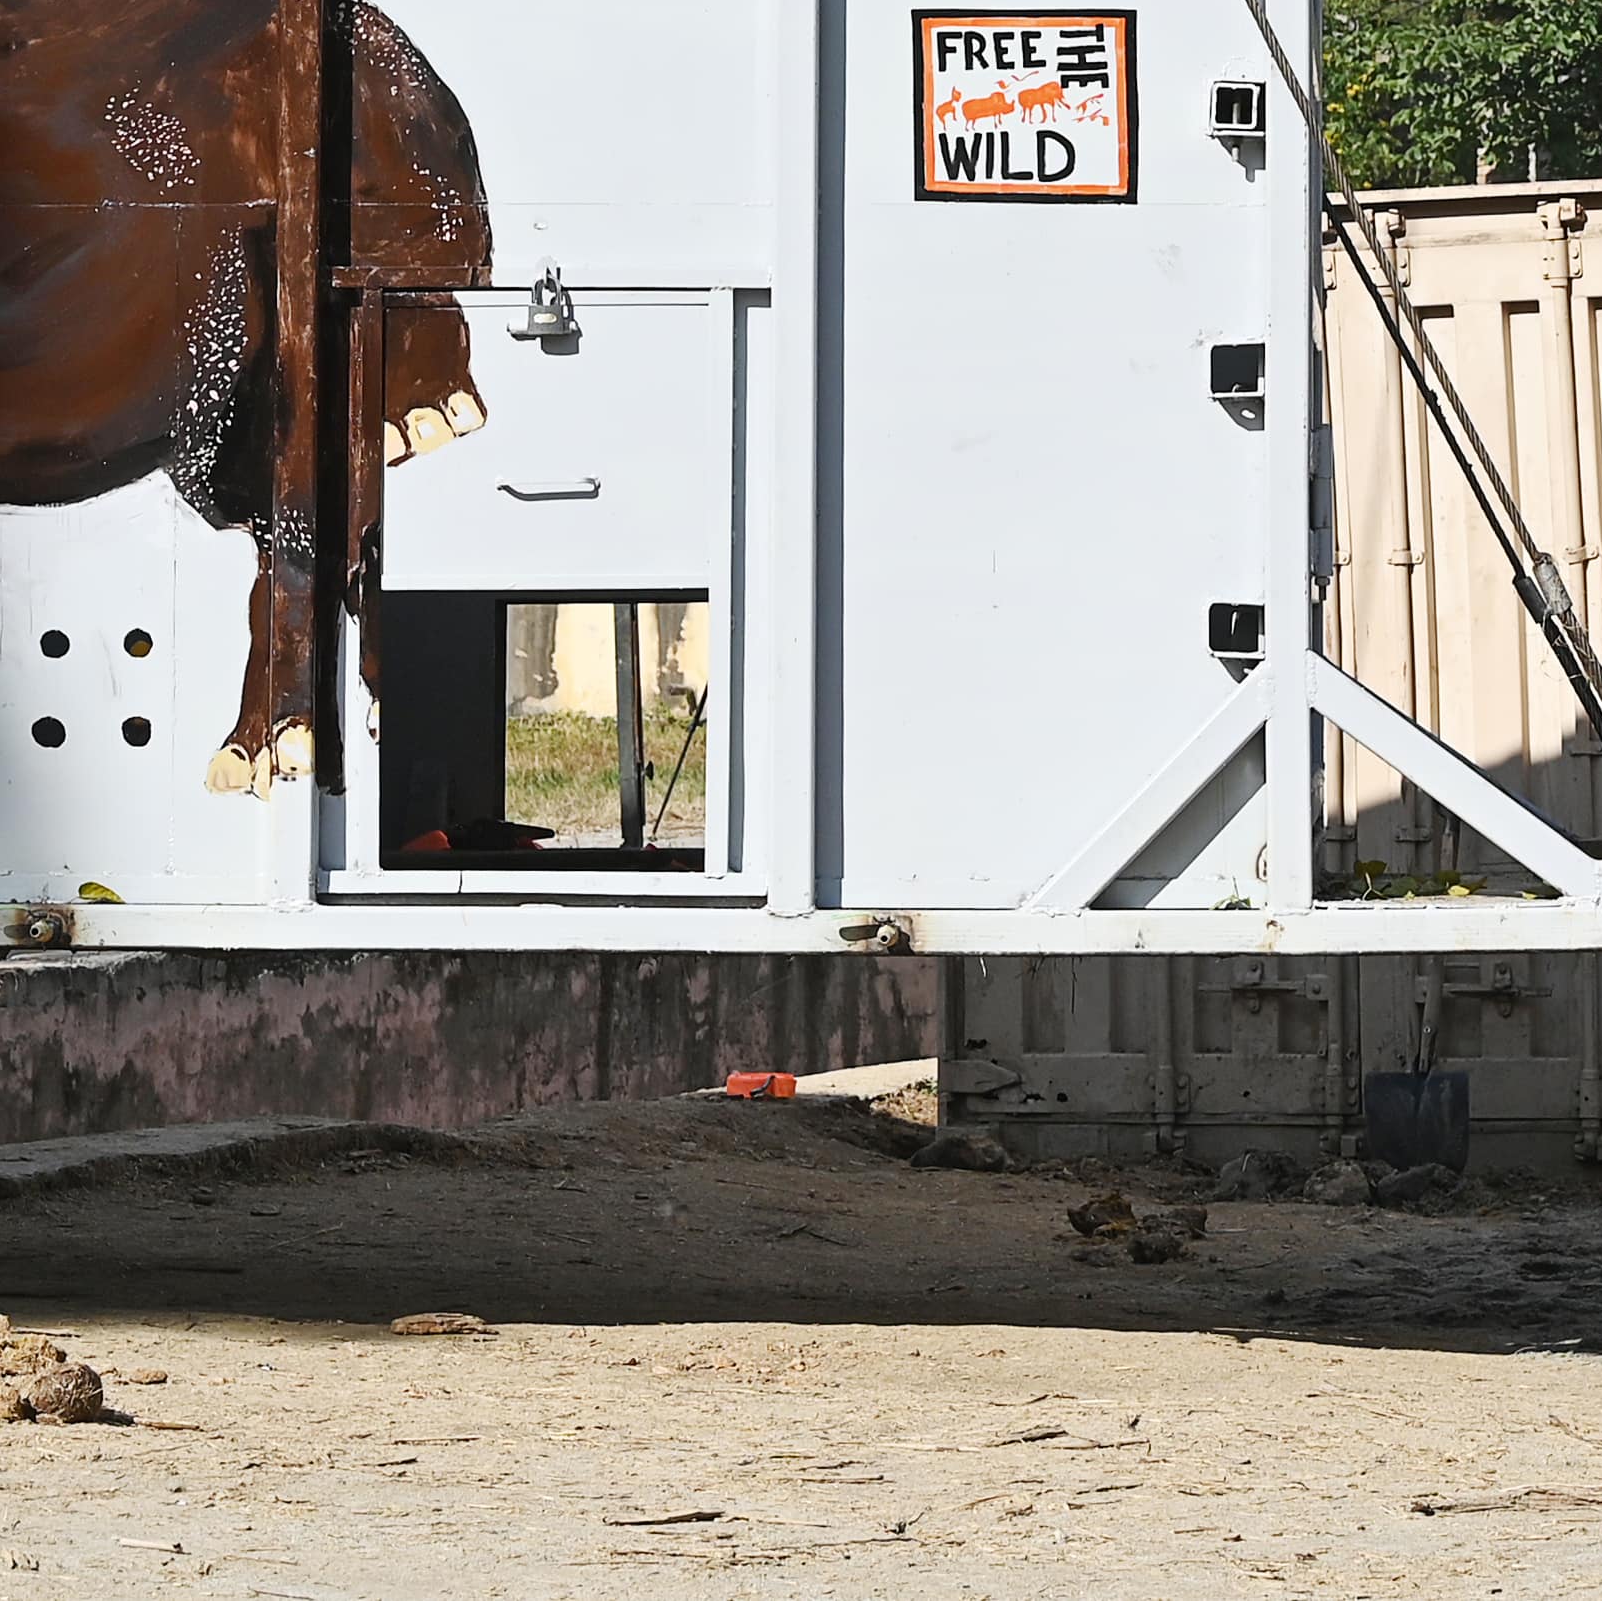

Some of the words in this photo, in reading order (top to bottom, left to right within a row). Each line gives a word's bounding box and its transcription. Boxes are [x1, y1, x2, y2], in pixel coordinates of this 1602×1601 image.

[937, 30, 1047, 72] FREE
[1056, 23, 1109, 90] THE
[938, 130, 1077, 183] WILD
